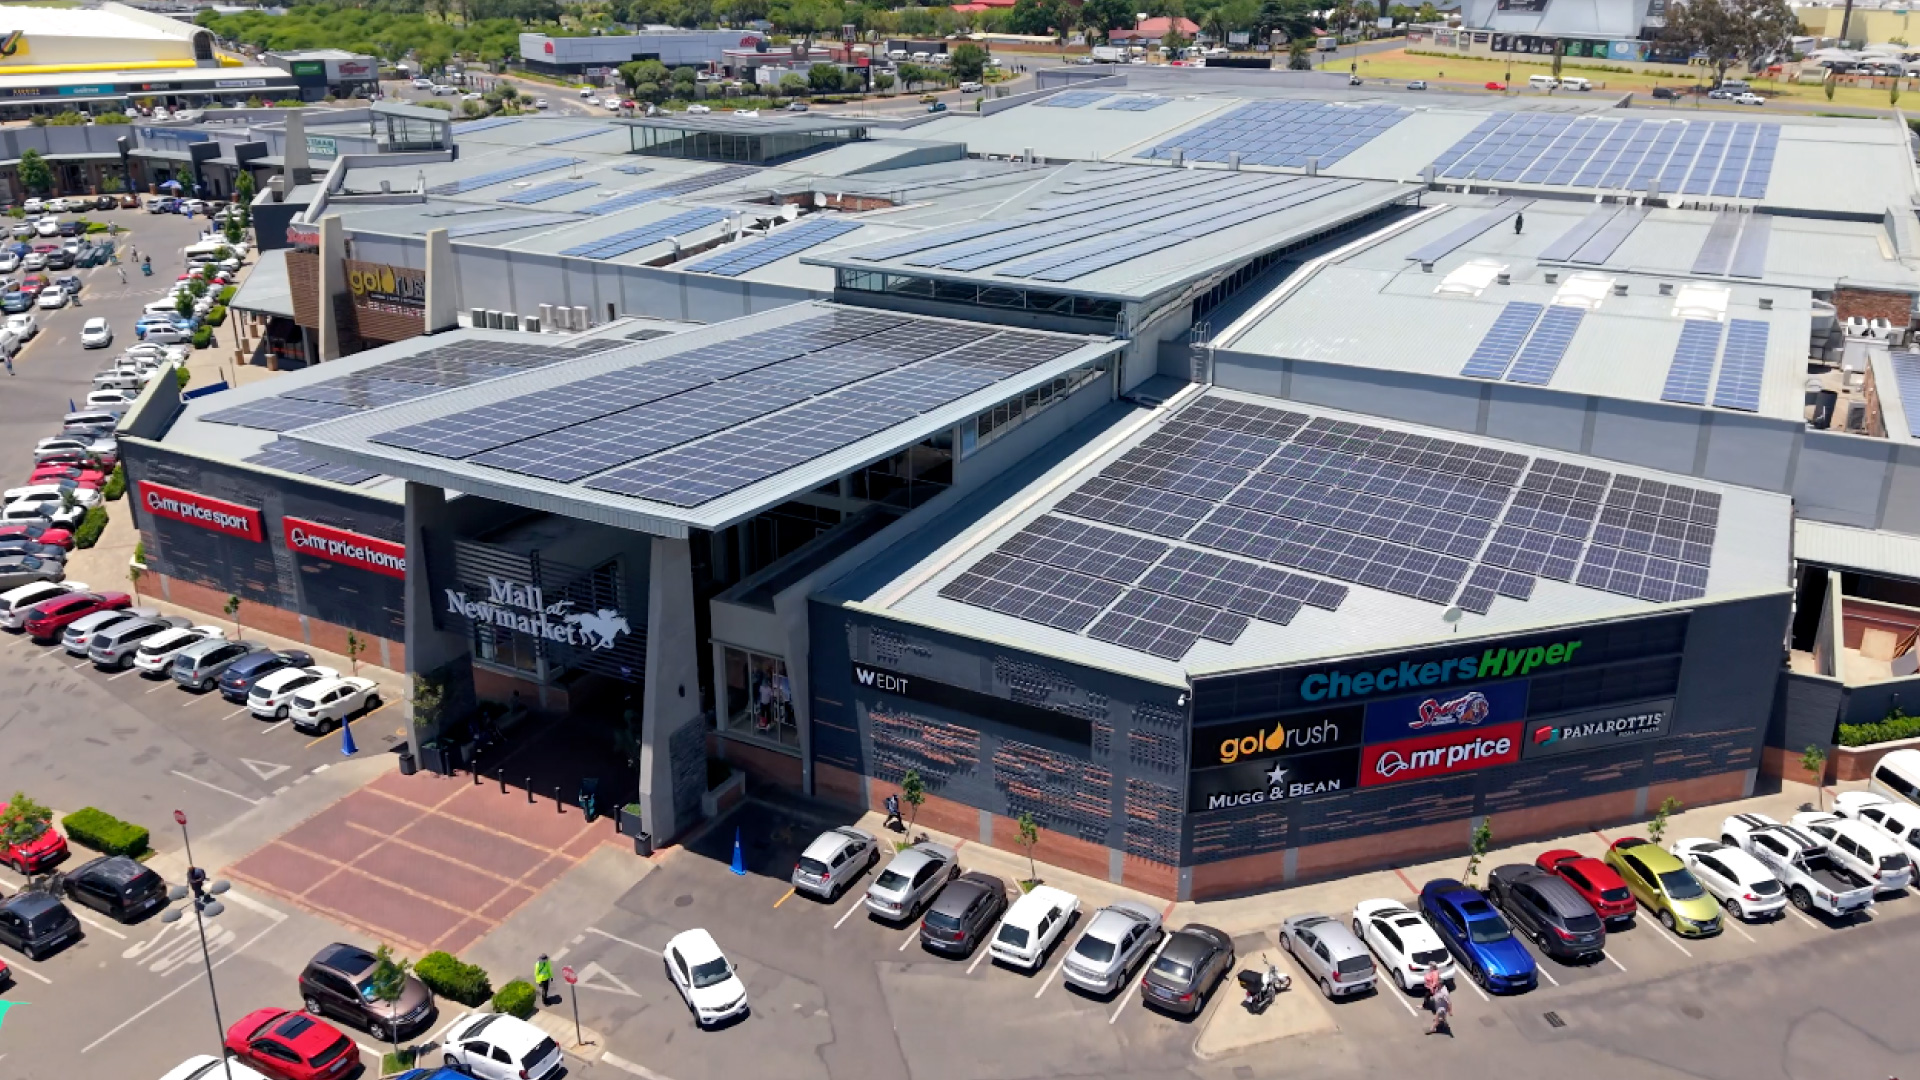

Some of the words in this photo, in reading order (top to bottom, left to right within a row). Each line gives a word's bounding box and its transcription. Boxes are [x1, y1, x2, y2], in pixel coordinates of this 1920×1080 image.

[161, 497, 179, 513] mr
[180, 502, 212, 522] price
[211, 510, 249, 532] sport
[308, 534, 328, 552] mr
[329, 538, 365, 560] price
[365, 545, 406, 571] home
[488, 576, 544, 613] Mall
[546, 599, 575, 616] at
[445, 588, 579, 645] Newmarket
[876, 673, 908, 695] EDIT
[1563, 713, 1662, 740] PANAROTTIS
[1409, 746, 1447, 770] mr
[1447, 736, 1511, 768] price
[1208, 791, 1264, 810] MUGG
[1269, 785, 1284, 801] &
[1289, 779, 1341, 798] BEAN
